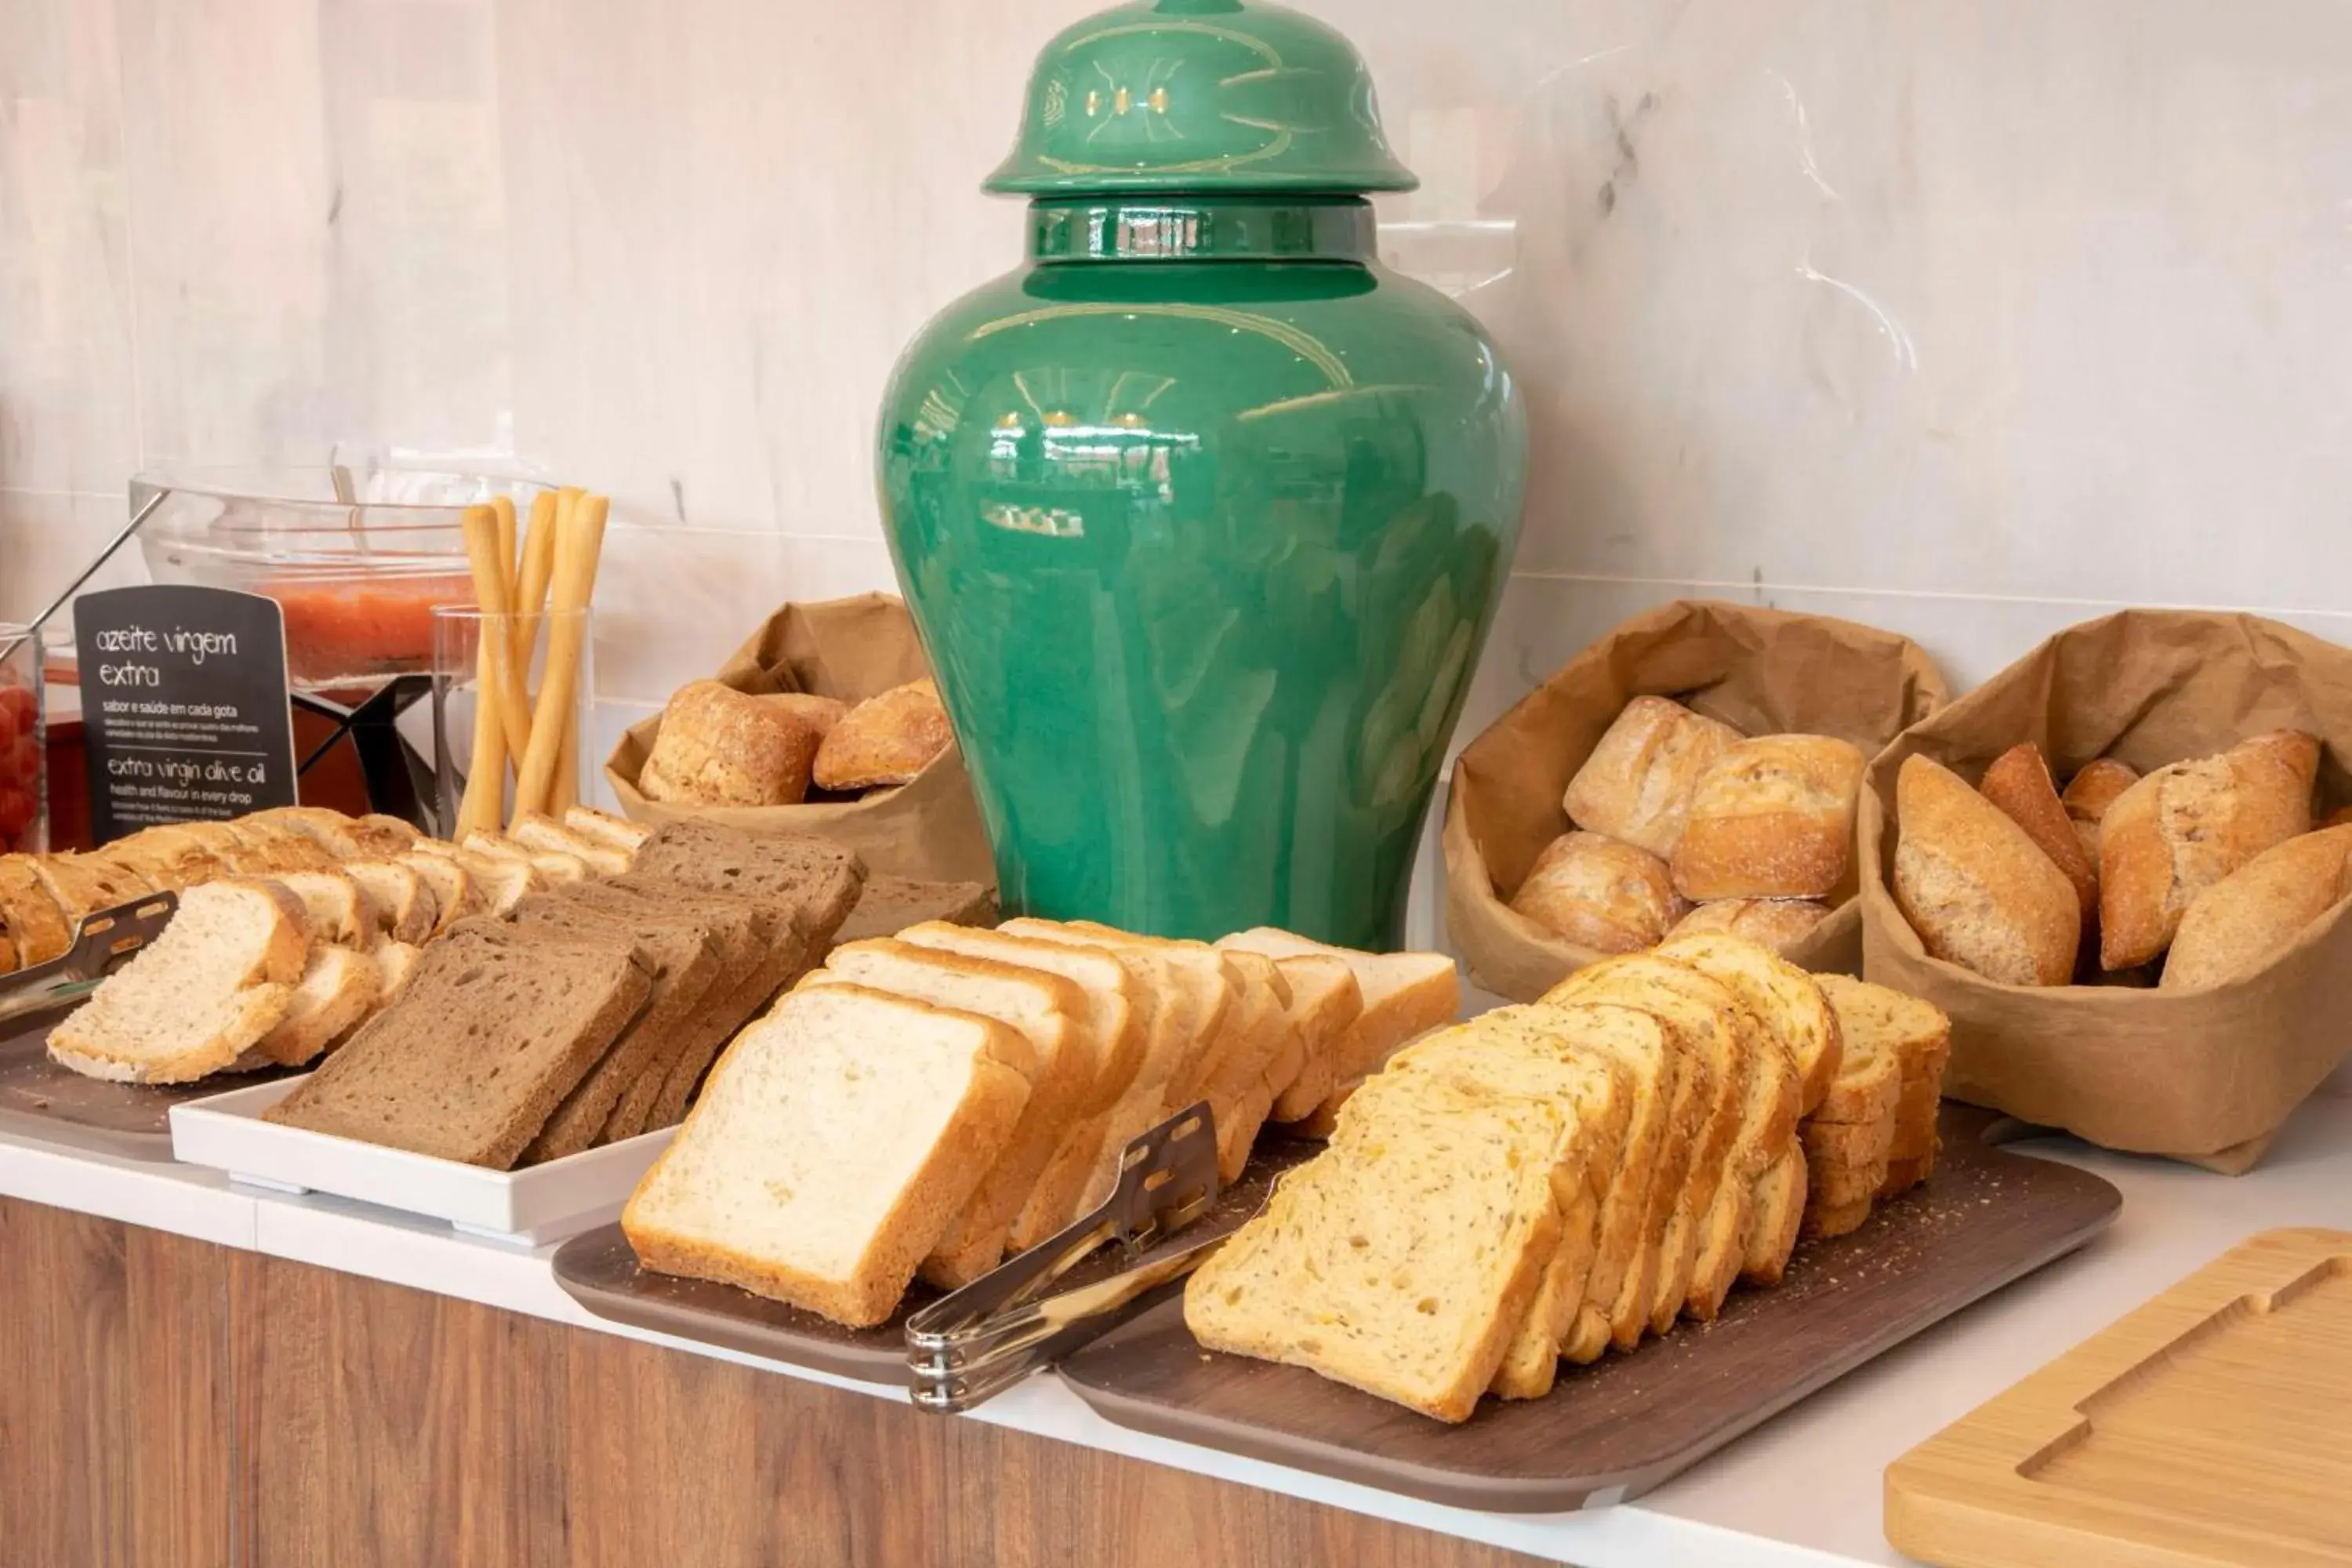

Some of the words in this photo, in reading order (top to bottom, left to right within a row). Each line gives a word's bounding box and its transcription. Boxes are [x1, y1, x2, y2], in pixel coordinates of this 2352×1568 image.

[96, 625, 158, 652] azeite
[164, 626, 237, 665] virgem
[100, 660, 160, 687] extra
[102, 699, 129, 713] sabor
[131, 702, 138, 713] e
[139, 700, 169, 714] saúde
[170, 704, 187, 714] em
[188, 703, 212, 716] cada
[213, 704, 238, 719] gota
[107, 756, 153, 777] extra
[157, 757, 201, 787] virgin
[205, 760, 244, 782] olive
[247, 763, 267, 784] oil
[110, 783, 138, 796] health
[140, 786, 157, 797] and
[158, 785, 188, 800] flavour
[191, 788, 200, 800] in
[201, 790, 227, 804] every
[228, 791, 252, 806] drop
